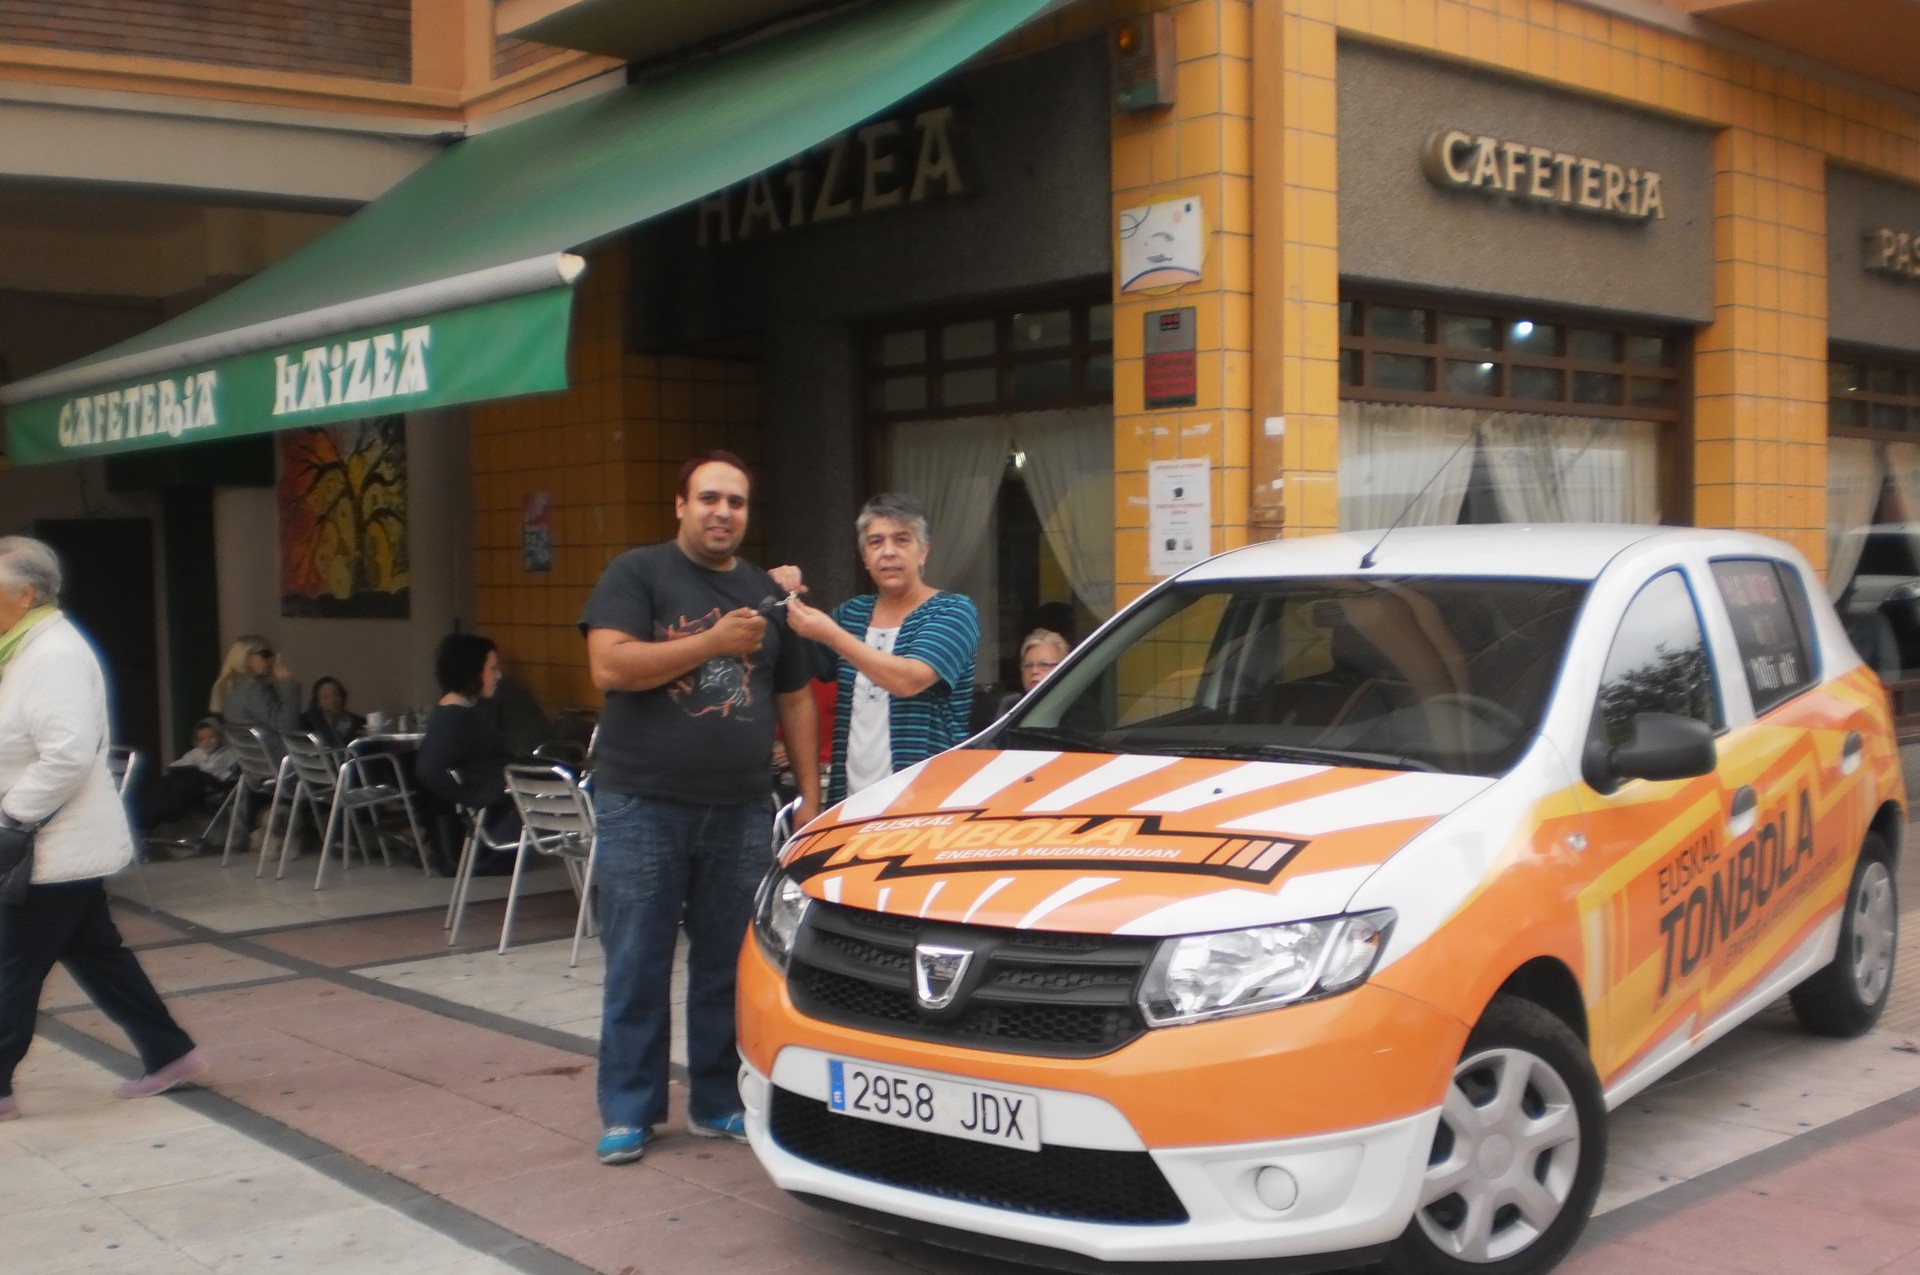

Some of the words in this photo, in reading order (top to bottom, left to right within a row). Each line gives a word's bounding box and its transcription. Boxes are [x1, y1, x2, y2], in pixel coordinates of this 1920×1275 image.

[834, 818, 1136, 862] TONBOLA
[858, 815, 955, 834] EUSKAL
[934, 847, 1017, 861] ENERGIA
[1020, 847, 1182, 859] MUGIMENDUAN
[1658, 829, 1719, 905] EUSKAL
[1659, 788, 1814, 998] TONBOLA
[853, 1071, 934, 1123] 2958
[960, 1091, 1024, 1141] JDX
